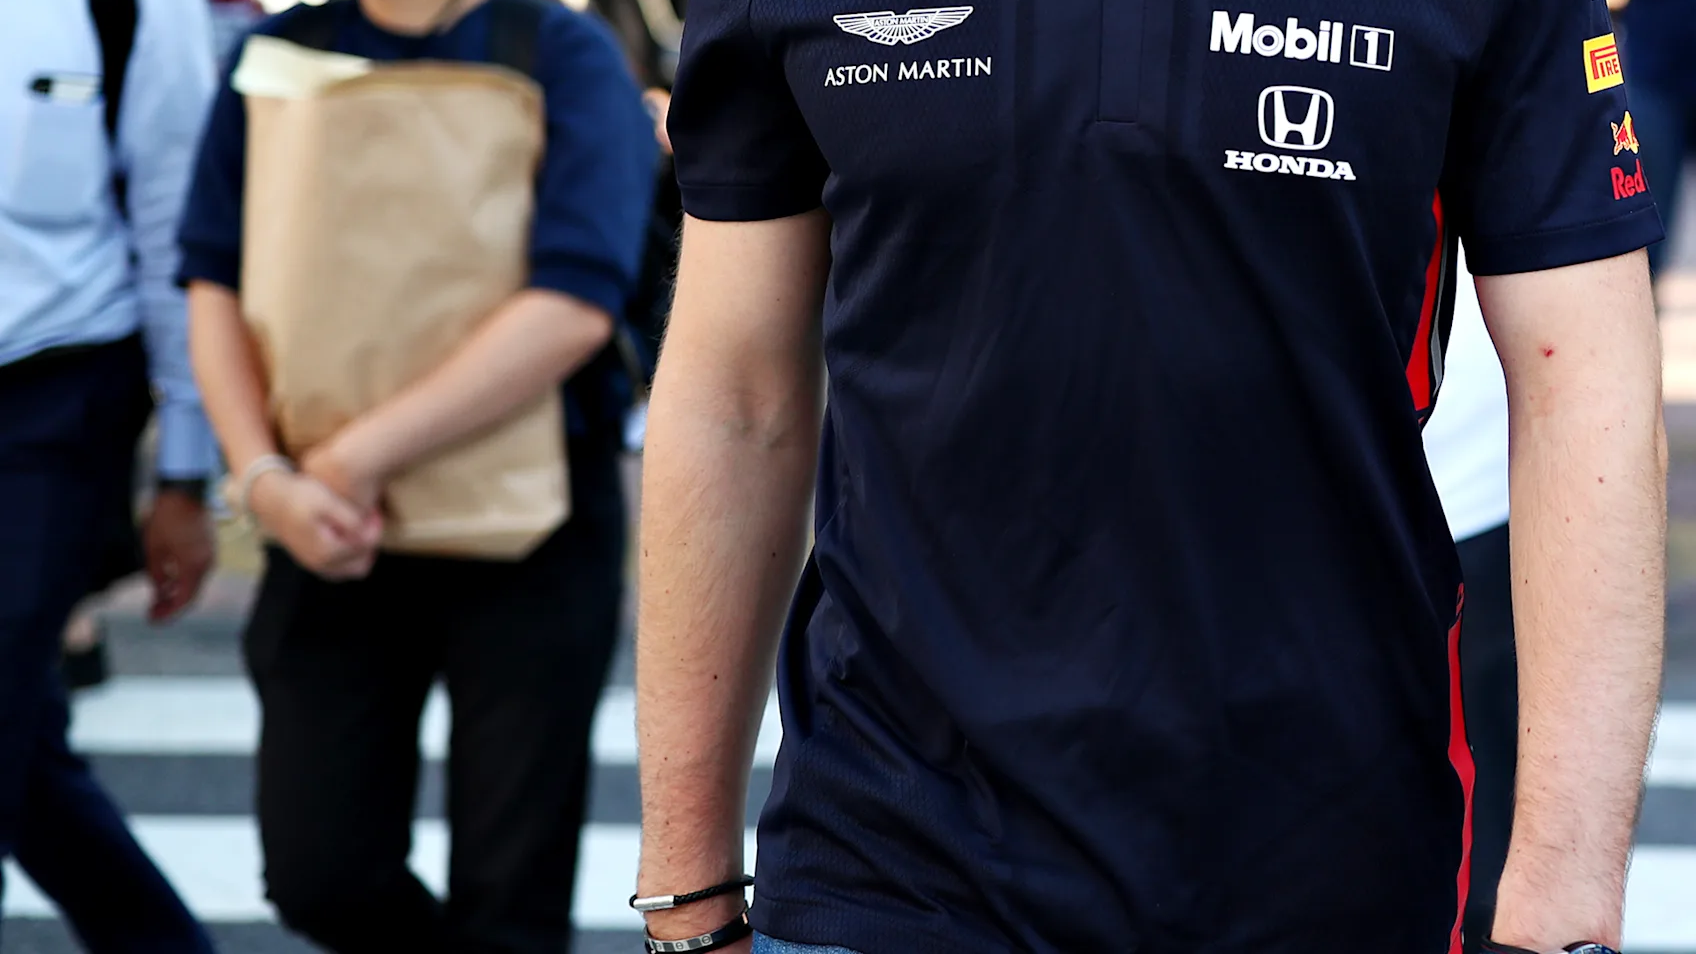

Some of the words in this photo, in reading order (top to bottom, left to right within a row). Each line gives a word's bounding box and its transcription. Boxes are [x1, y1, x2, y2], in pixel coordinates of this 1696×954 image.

[1210, 10, 1343, 63] Mobil
[824, 63, 888, 87] ASTON
[899, 57, 992, 80] MARTIN
[1223, 149, 1356, 181] HONDA
[1610, 158, 1646, 200] Red
